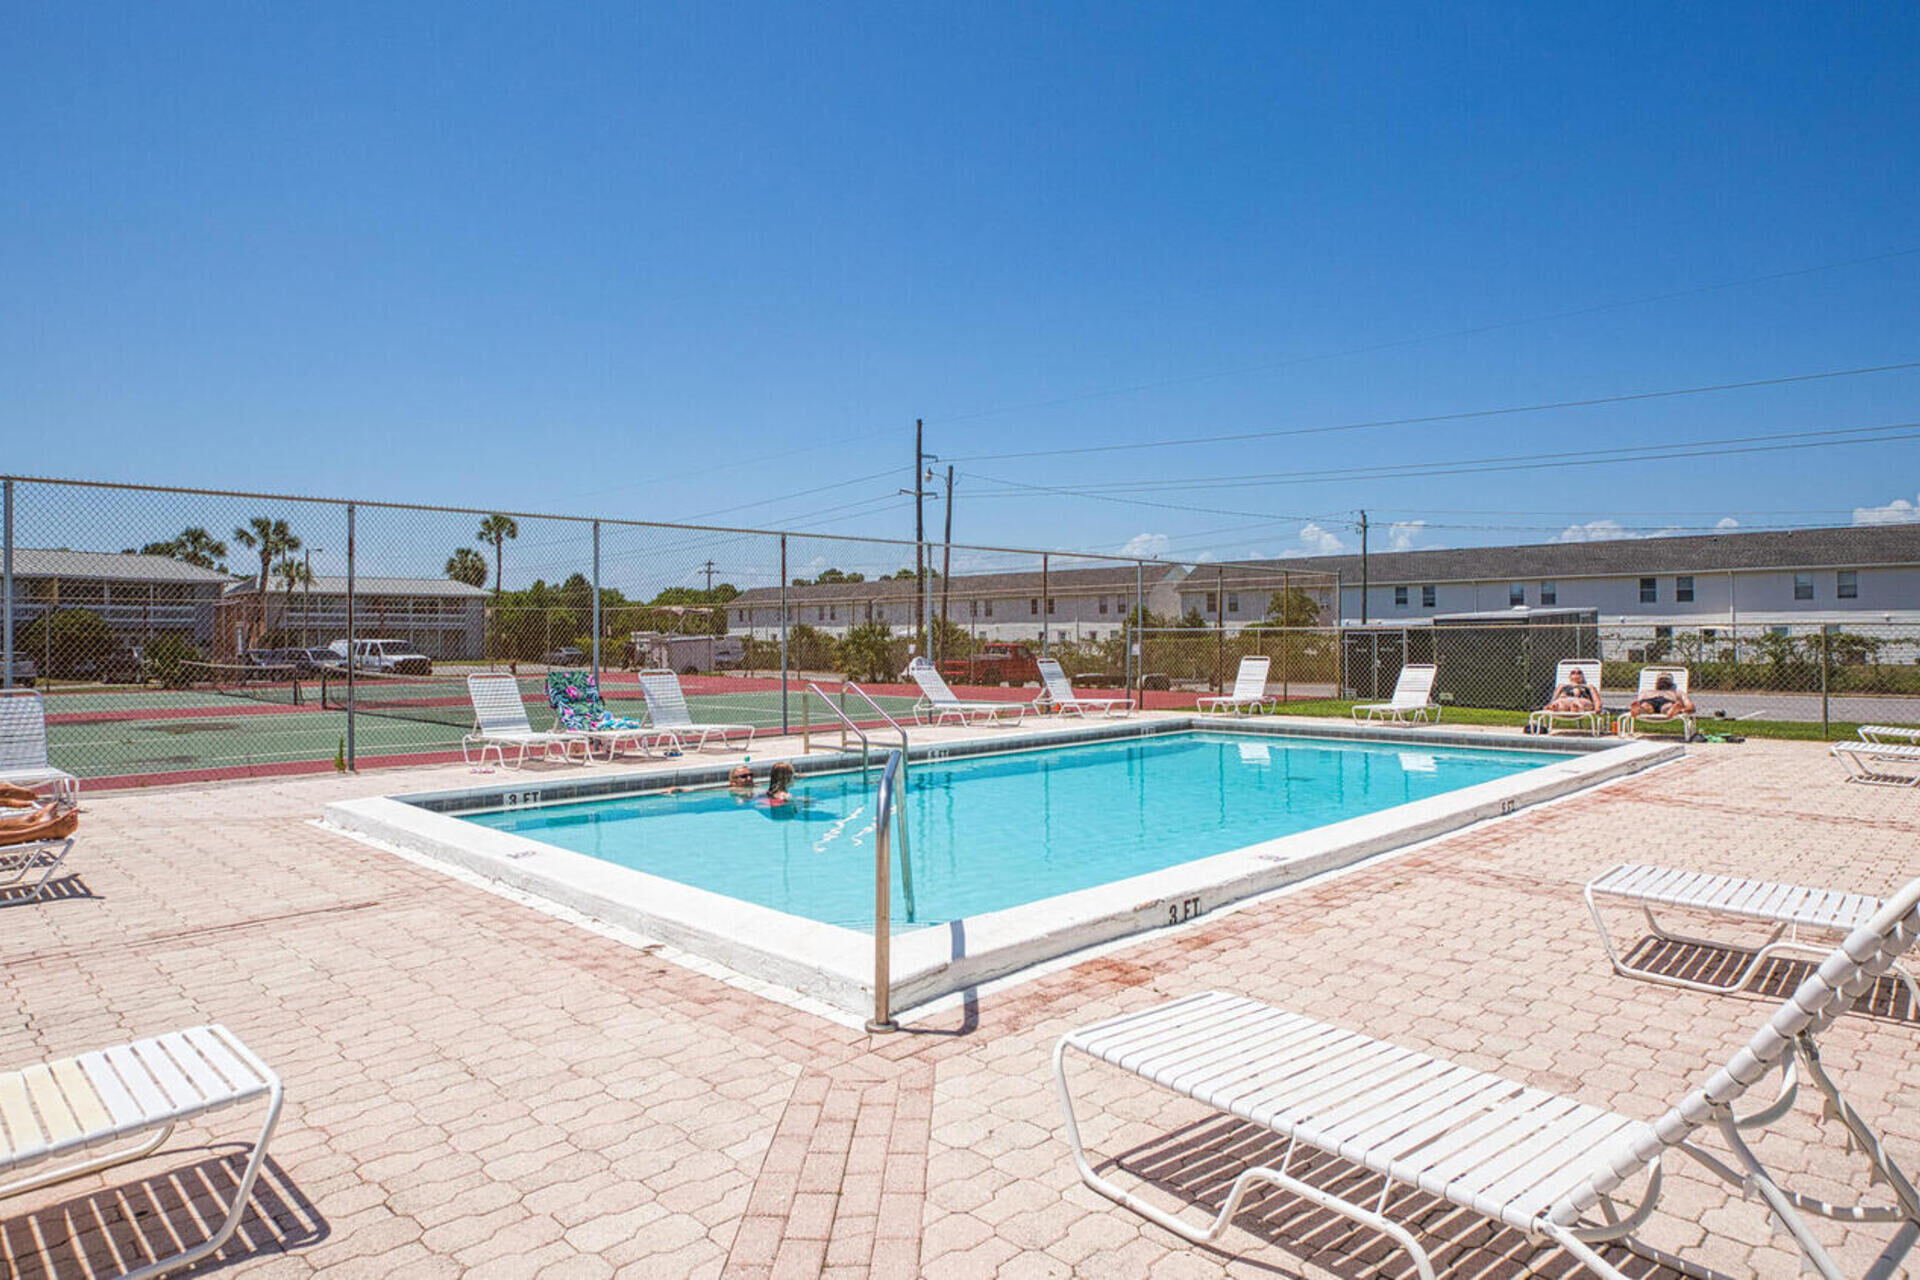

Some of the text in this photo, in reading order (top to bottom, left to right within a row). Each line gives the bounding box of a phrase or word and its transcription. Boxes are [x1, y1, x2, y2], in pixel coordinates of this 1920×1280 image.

[509, 791, 540, 805] 3 FT
[1169, 897, 1200, 925] 3 FT
